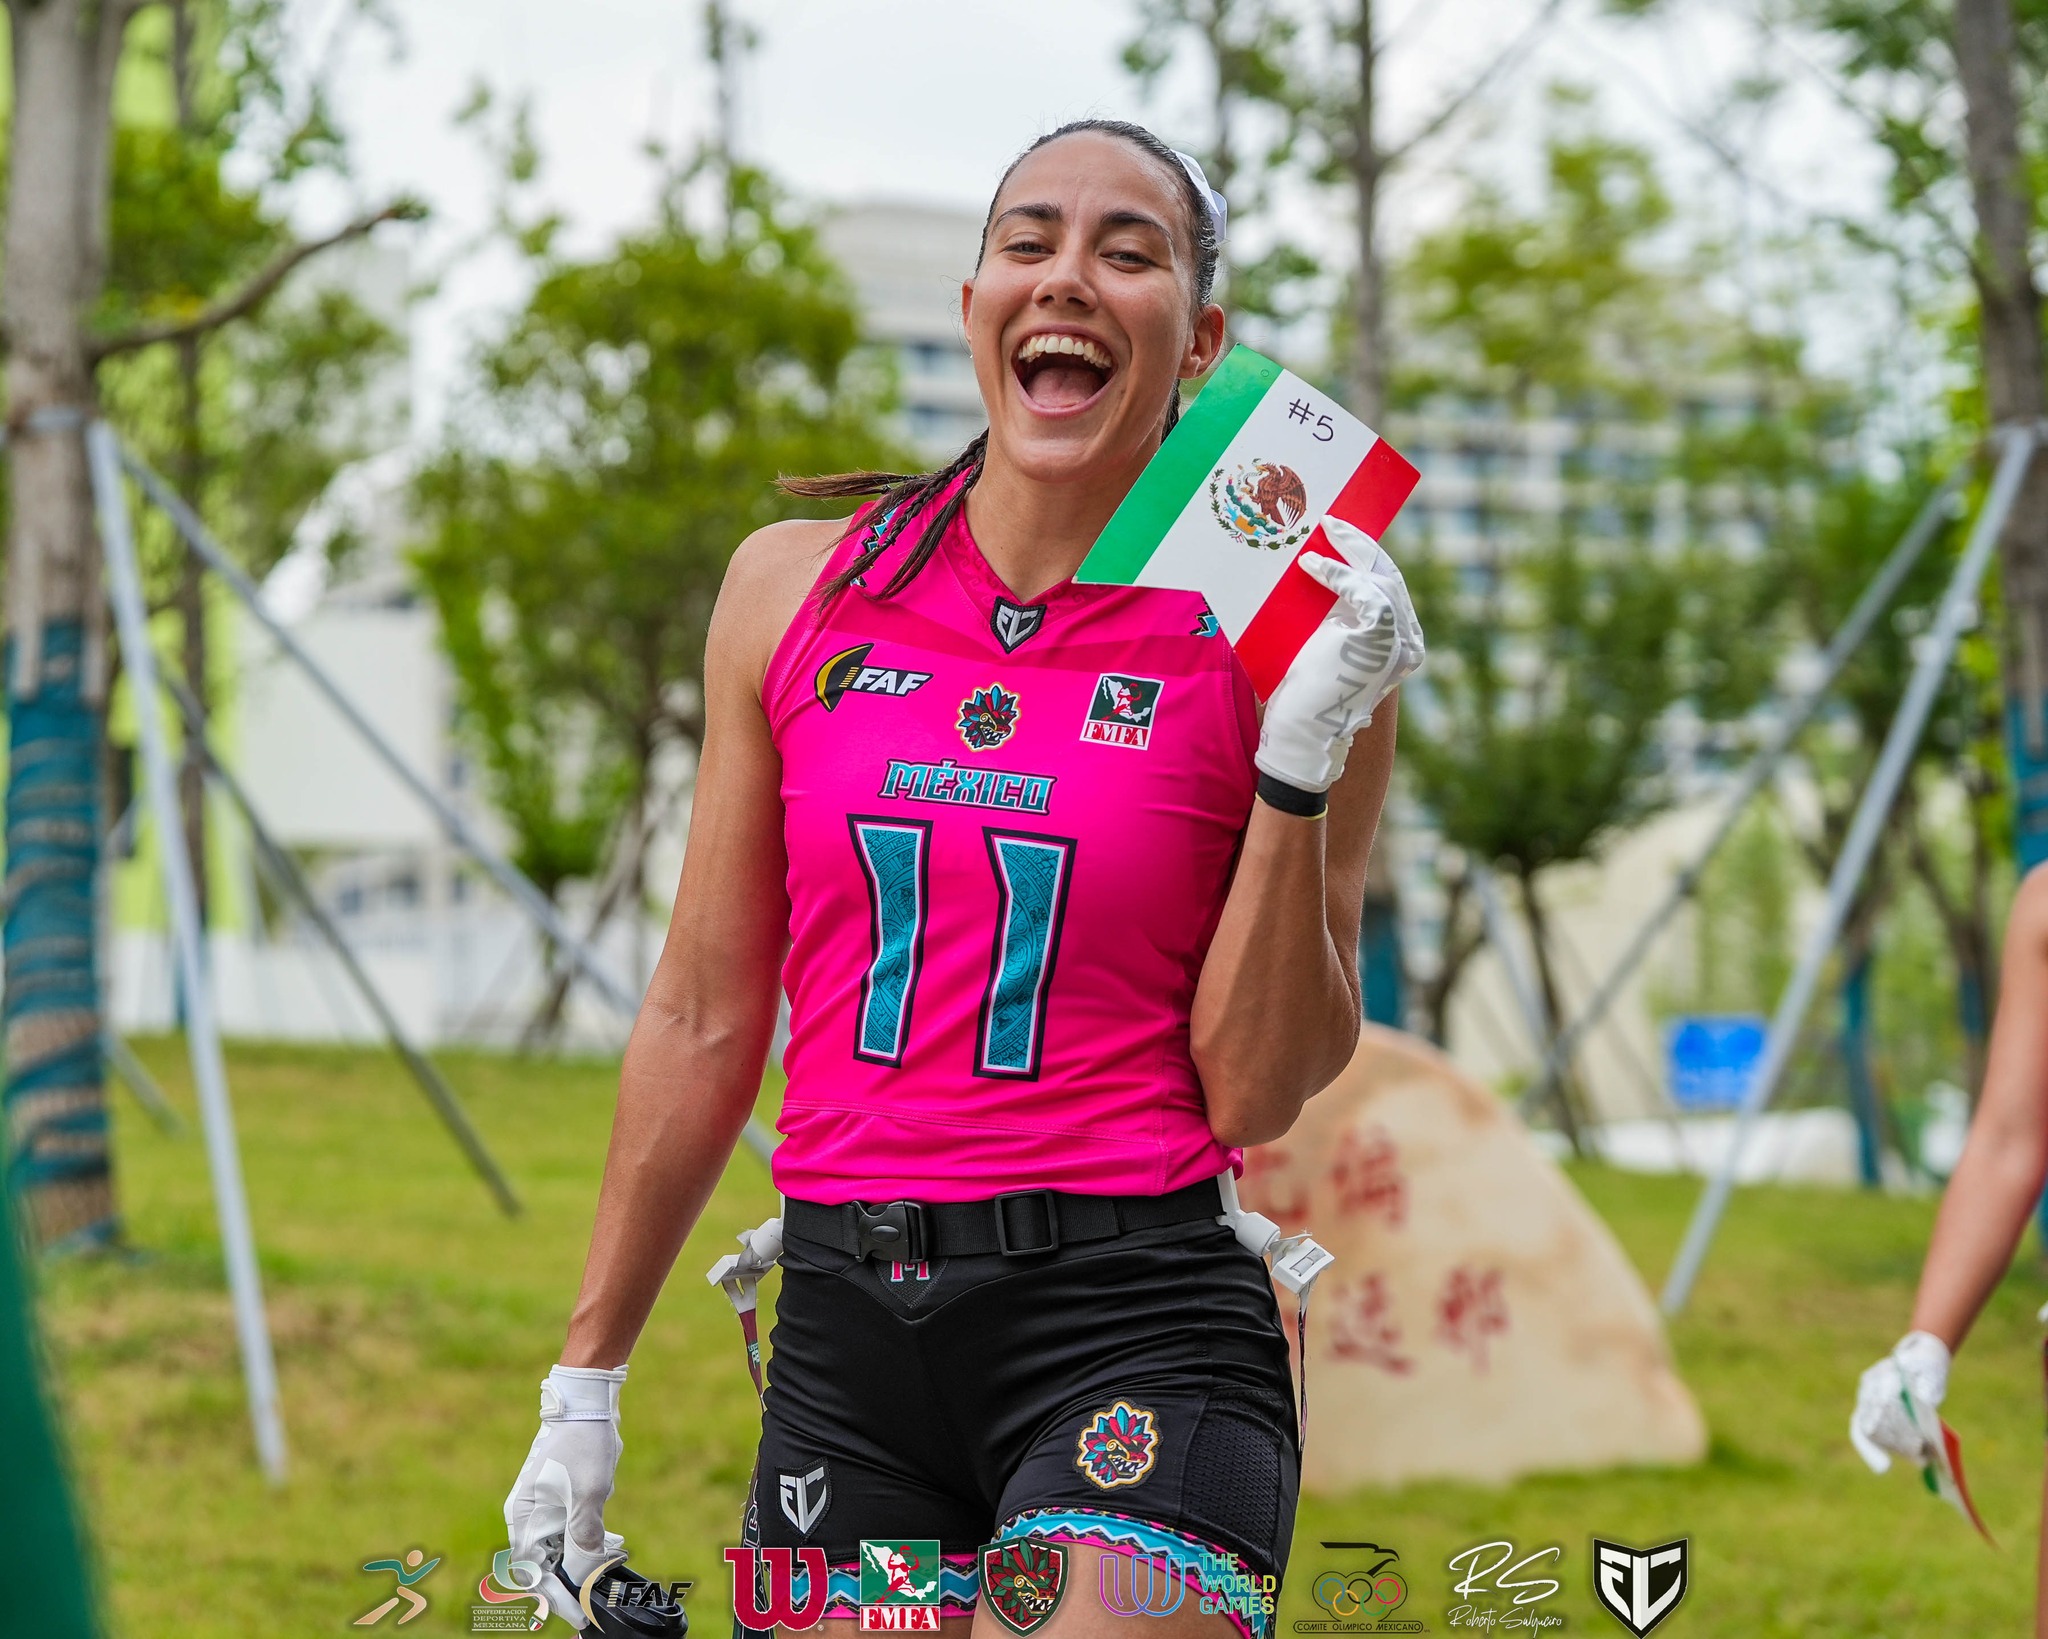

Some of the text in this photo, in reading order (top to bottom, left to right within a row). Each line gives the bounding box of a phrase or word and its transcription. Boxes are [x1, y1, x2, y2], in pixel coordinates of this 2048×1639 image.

[1289, 398, 1334, 442] #5
[1085, 721, 1146, 747] FMFA
[878, 759, 1056, 815] MÉXICO
[846, 813, 1078, 1082] 11
